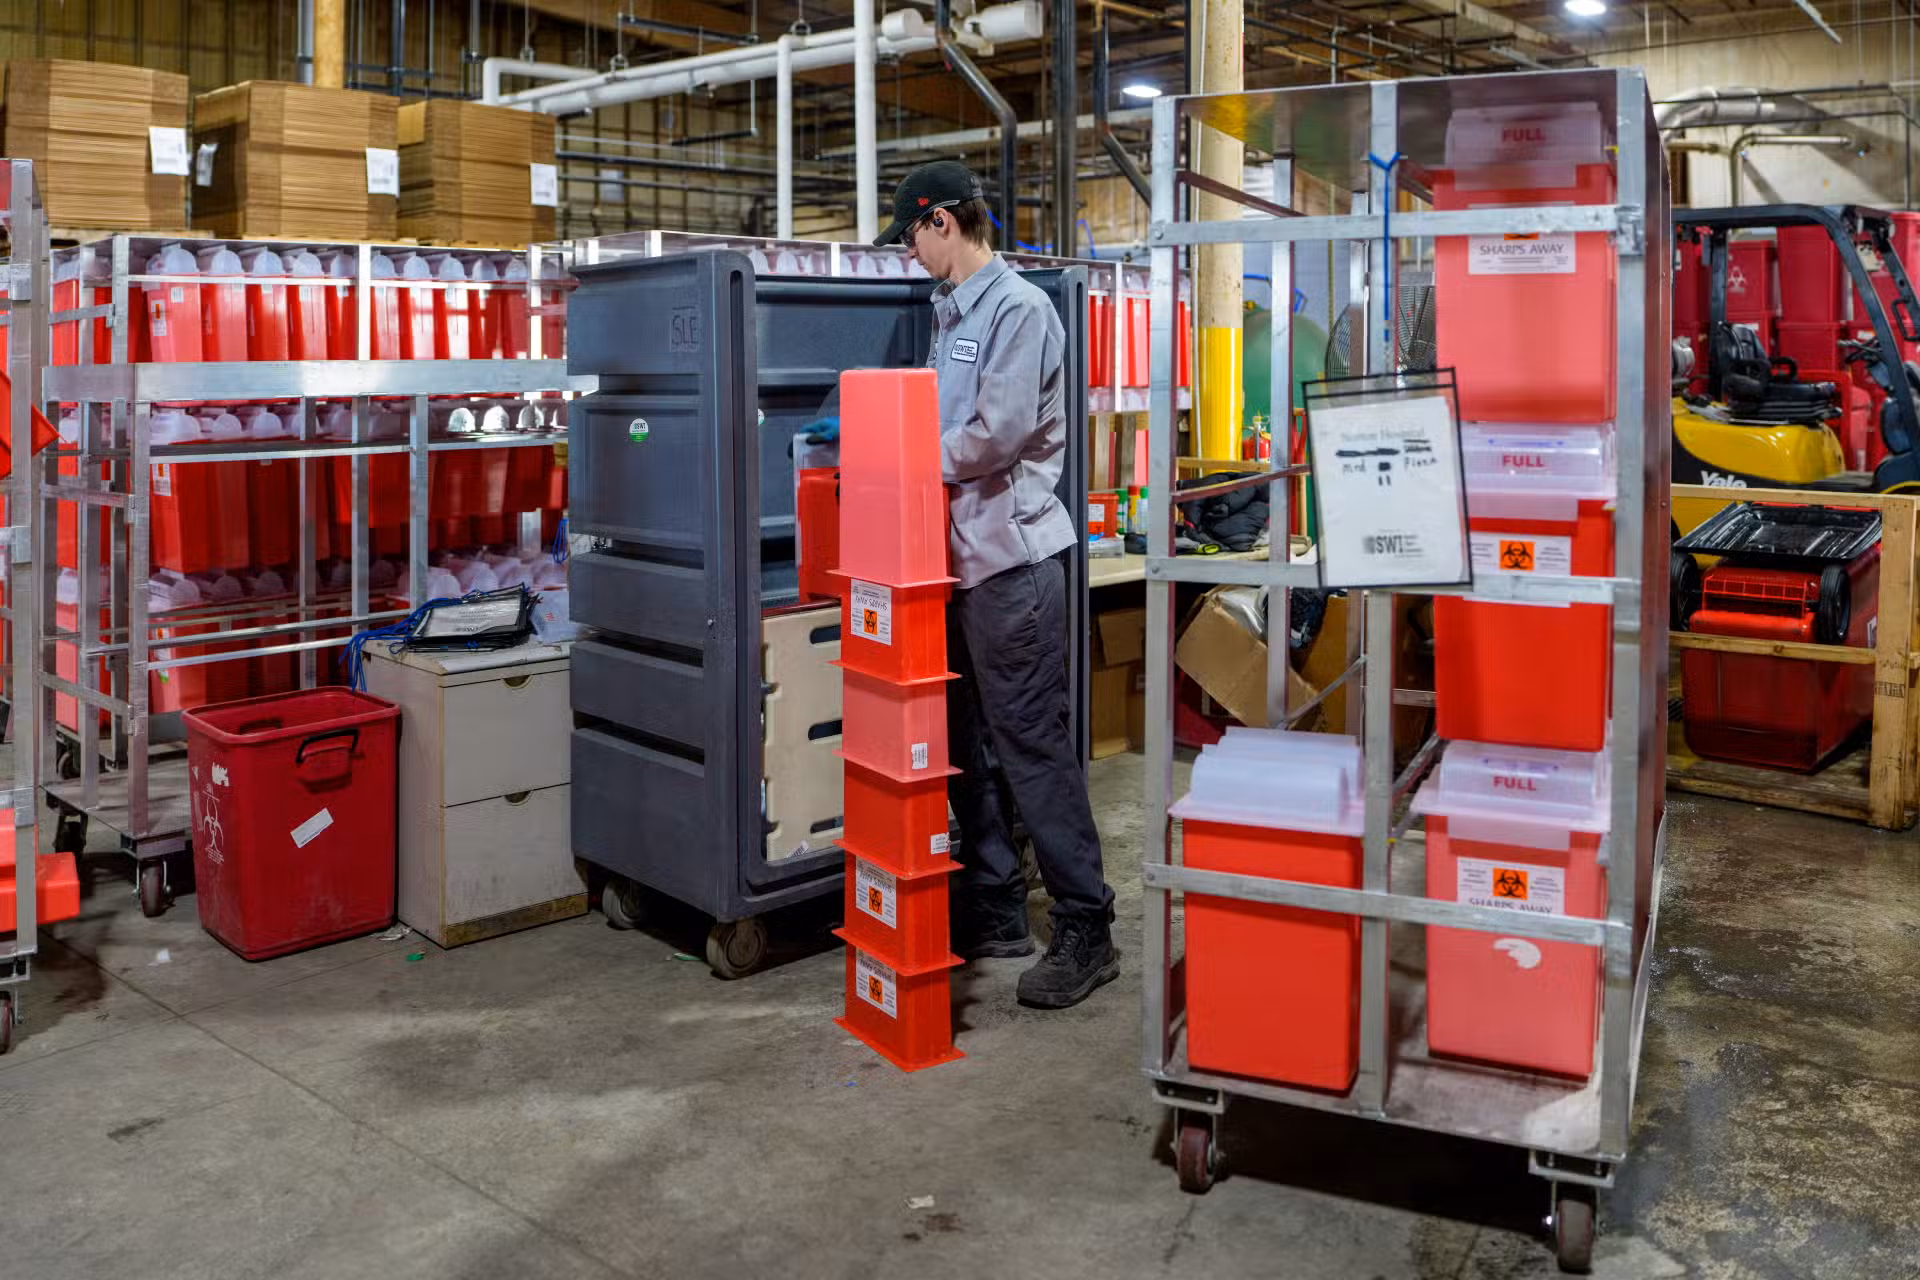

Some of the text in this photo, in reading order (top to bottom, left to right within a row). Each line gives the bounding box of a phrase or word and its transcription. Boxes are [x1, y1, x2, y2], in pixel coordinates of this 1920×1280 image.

[1502, 128, 1546, 142] FULL
[1479, 243, 1565, 255] SHARPS AWAY
[1502, 454, 1545, 468] FULL
[1701, 470, 1747, 488] Yale
[1493, 775, 1537, 791] FULL
